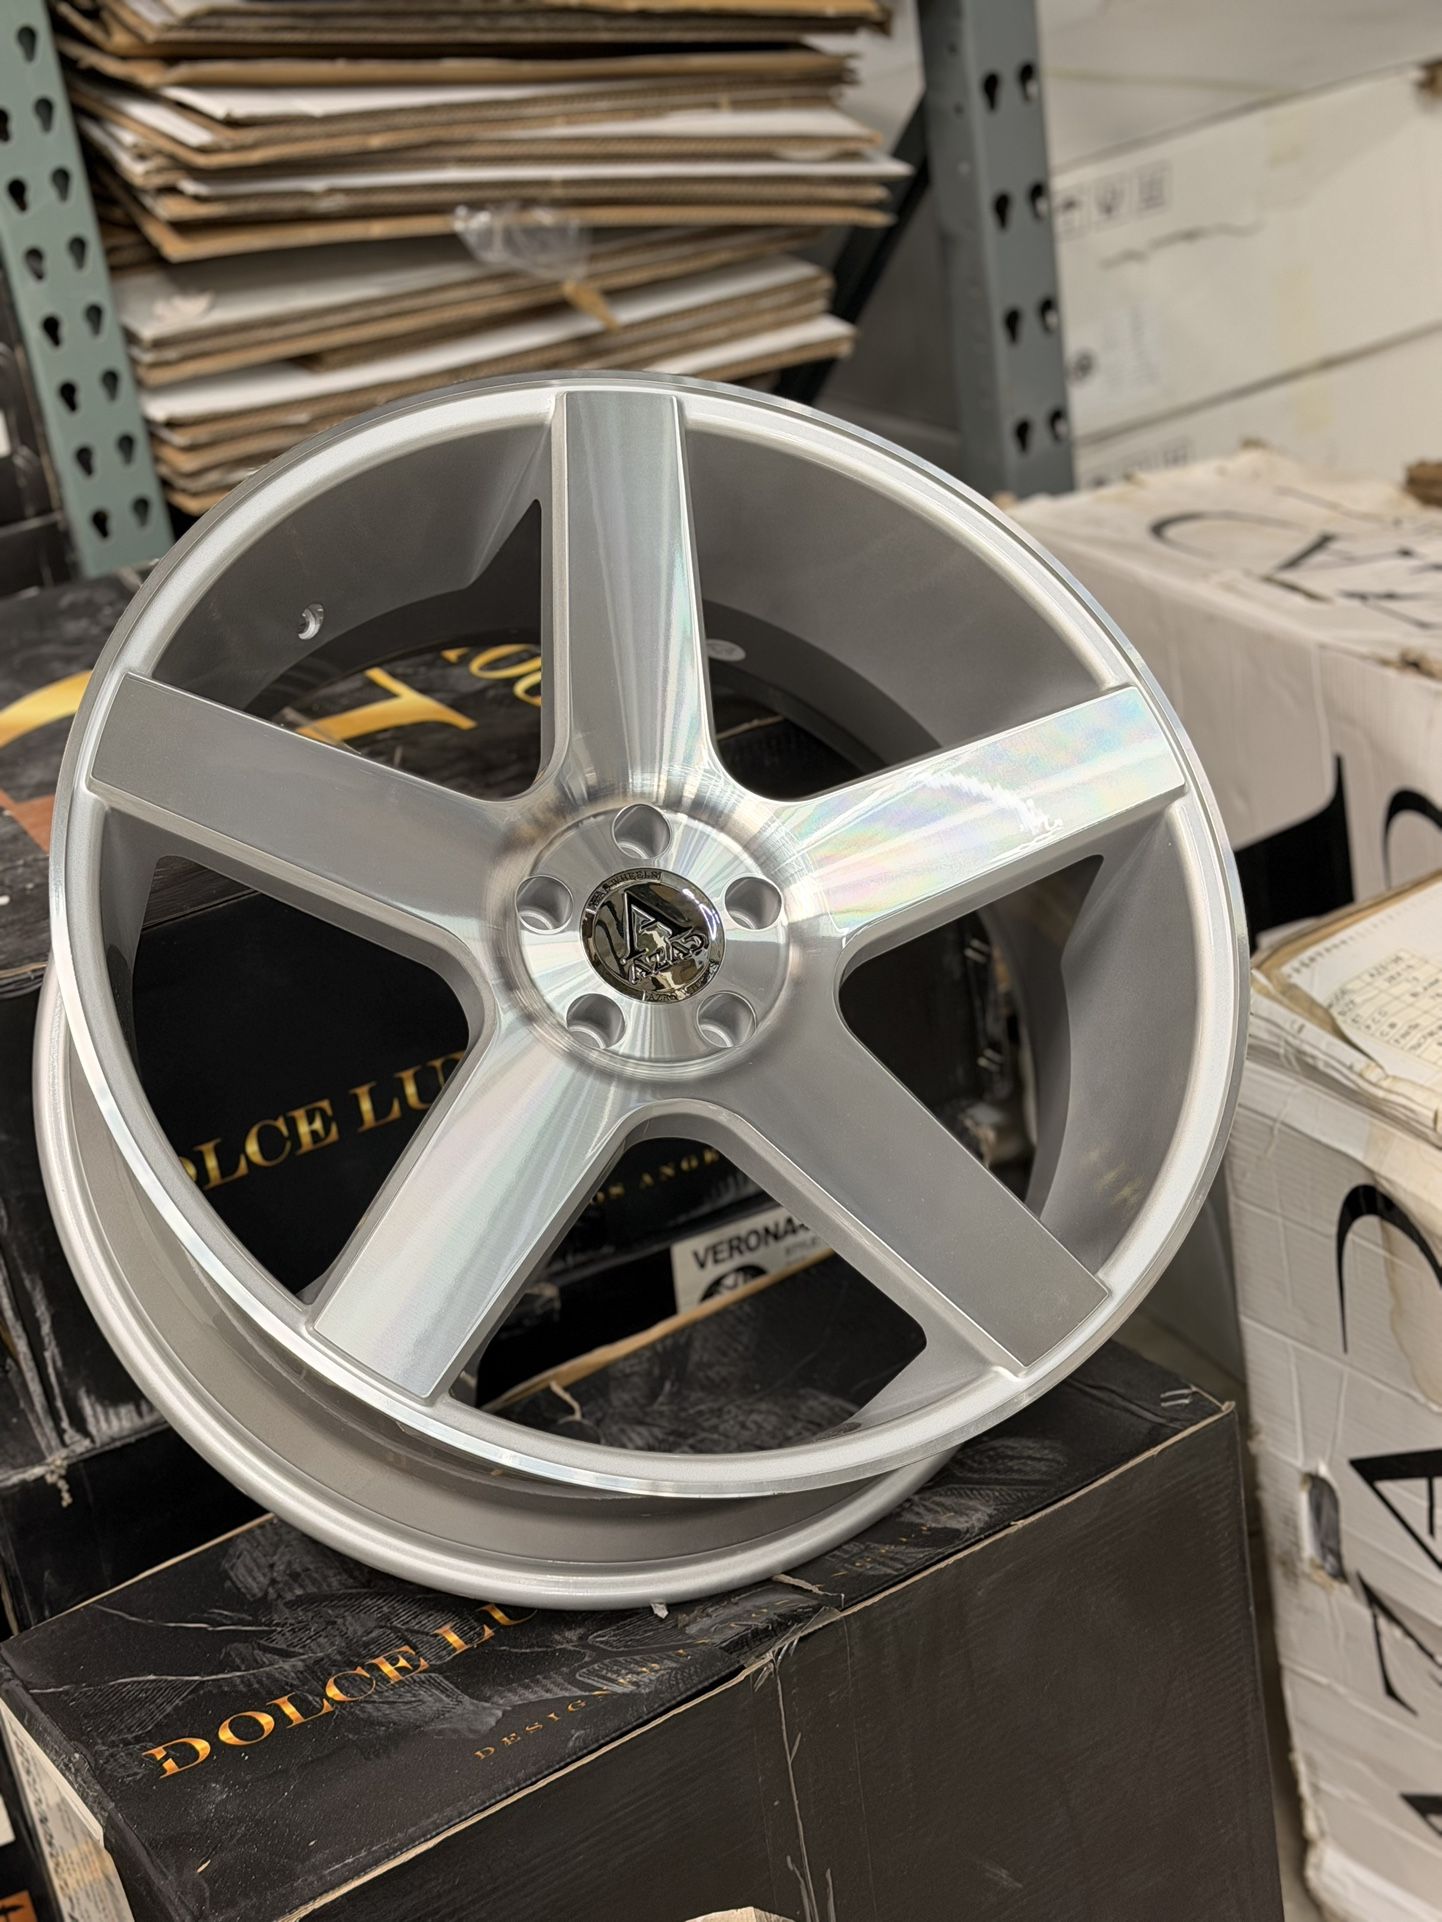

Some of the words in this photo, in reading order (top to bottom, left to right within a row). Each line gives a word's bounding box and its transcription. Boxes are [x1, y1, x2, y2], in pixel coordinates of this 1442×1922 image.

[178, 1098, 340, 1191] LCE
[692, 1214, 810, 1270] VERONA
[142, 1643, 431, 1780] DOLCE
